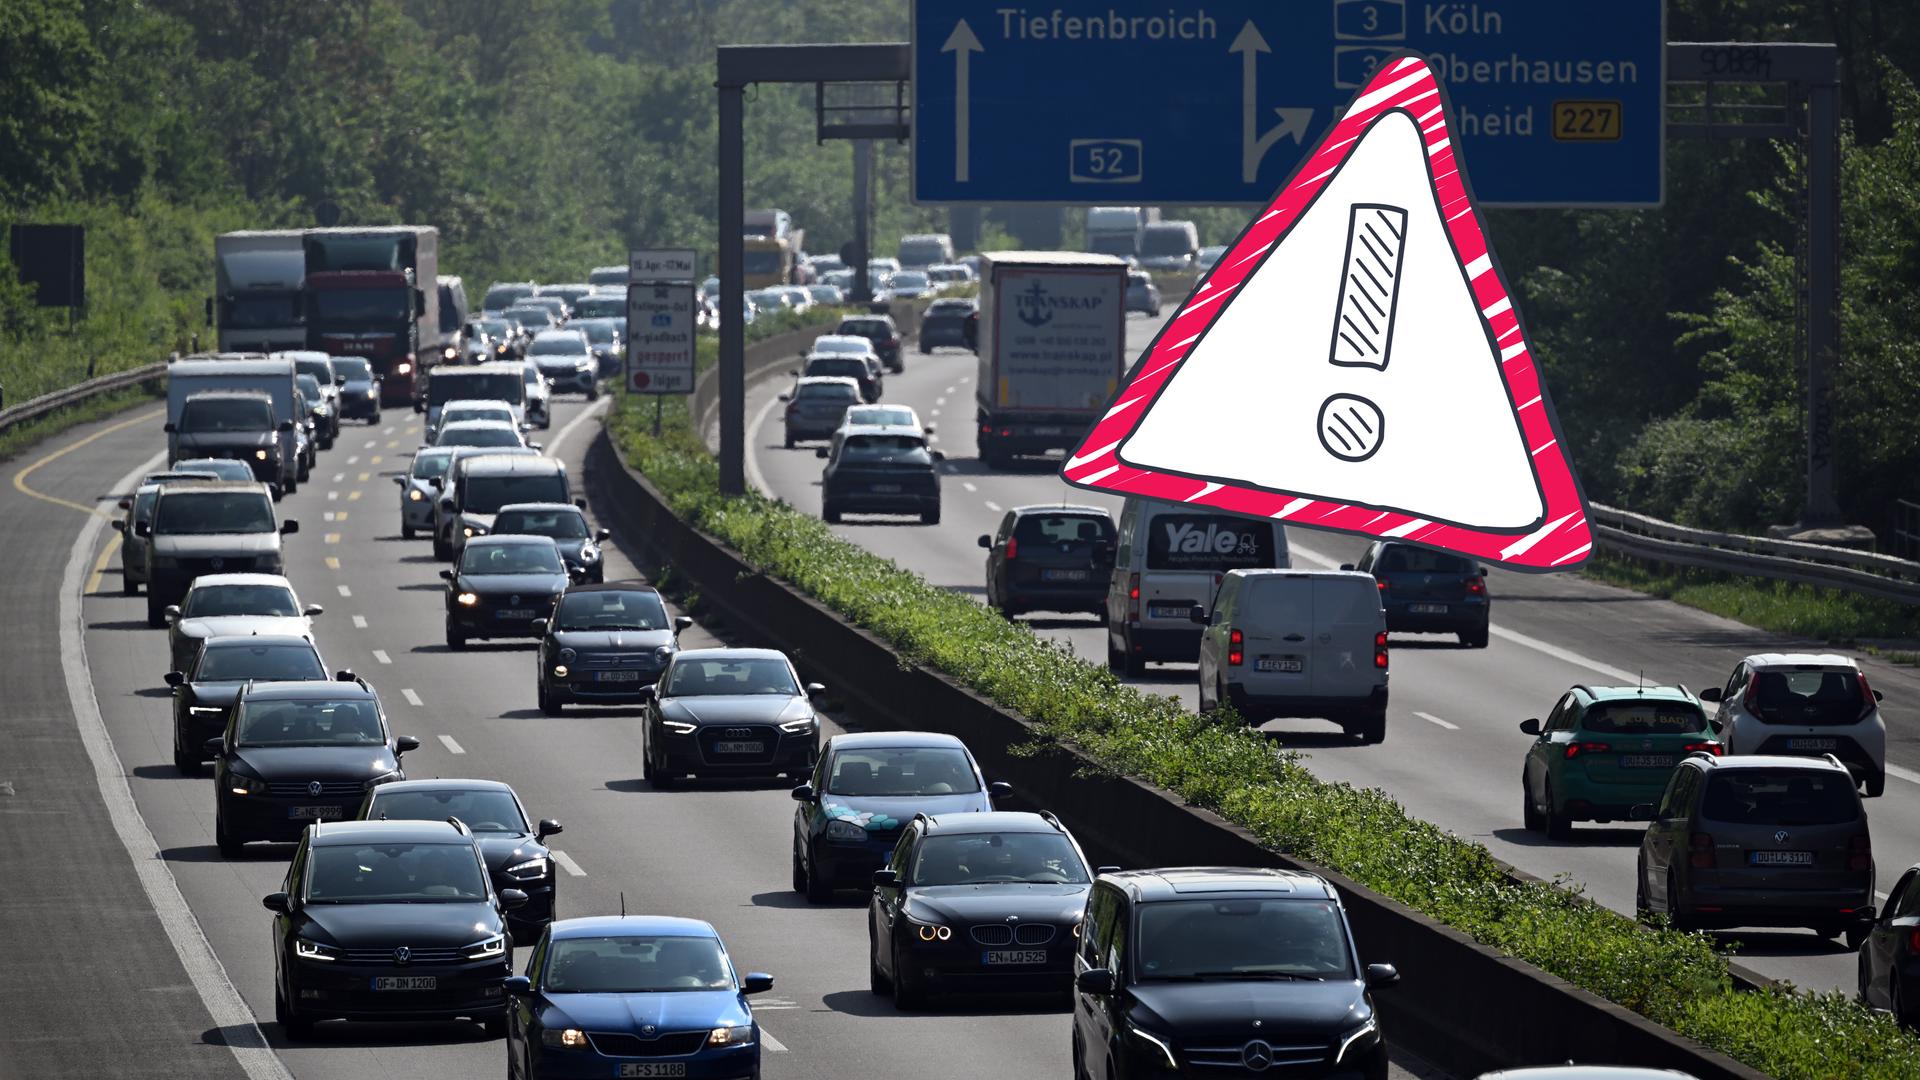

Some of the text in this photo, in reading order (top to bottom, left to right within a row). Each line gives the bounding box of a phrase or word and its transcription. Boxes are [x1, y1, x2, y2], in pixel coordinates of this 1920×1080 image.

[996, 9, 1217, 39] Tiefenbroich
[1362, 4, 1501, 34] 3 Köln
[1562, 108, 1613, 134] 227
[1089, 148, 1123, 173] 52
[1166, 523, 1238, 553] Yale
[1025, 950, 1045, 962] 525
[411, 977, 436, 990] 1200
[654, 1063, 684, 1076] 1188
